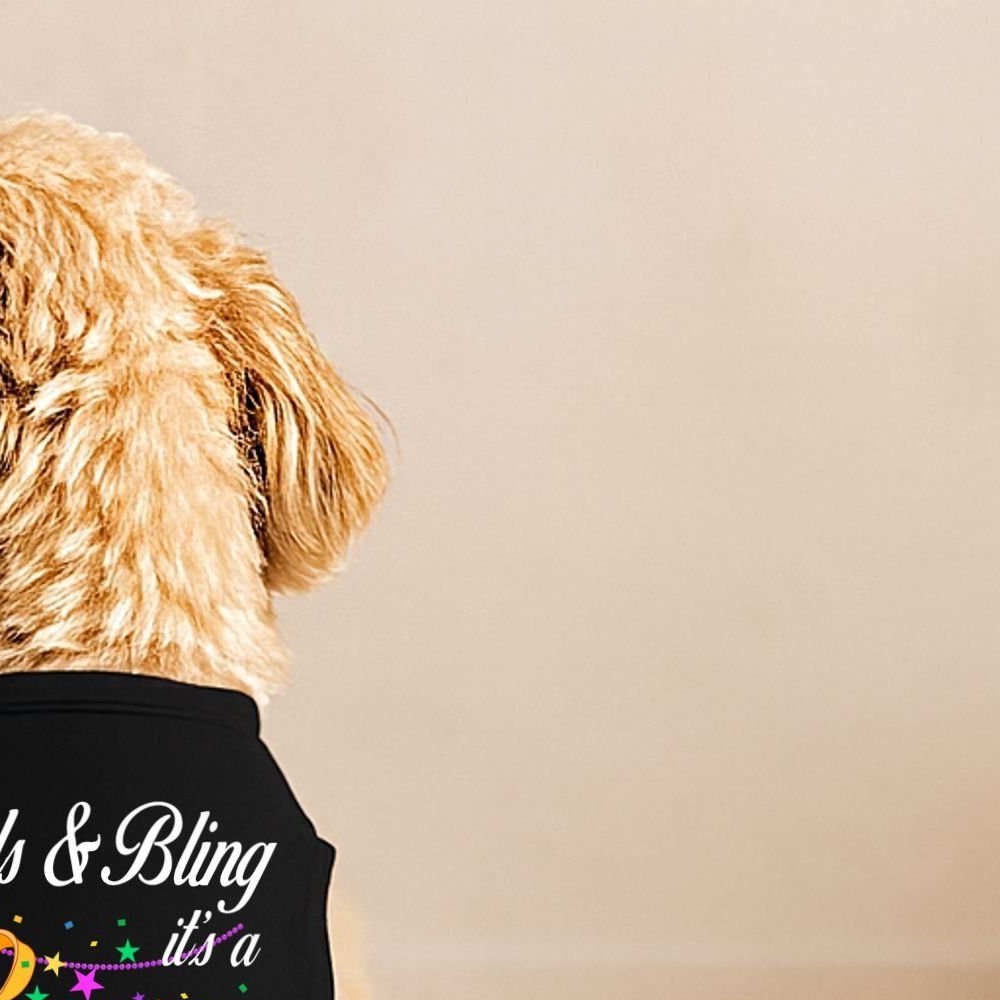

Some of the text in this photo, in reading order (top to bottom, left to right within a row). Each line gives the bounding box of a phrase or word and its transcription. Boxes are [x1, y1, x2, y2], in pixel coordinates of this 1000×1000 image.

[43, 801, 102, 887] &
[101, 801, 278, 914] Bling
[161, 909, 261, 968] it's a
